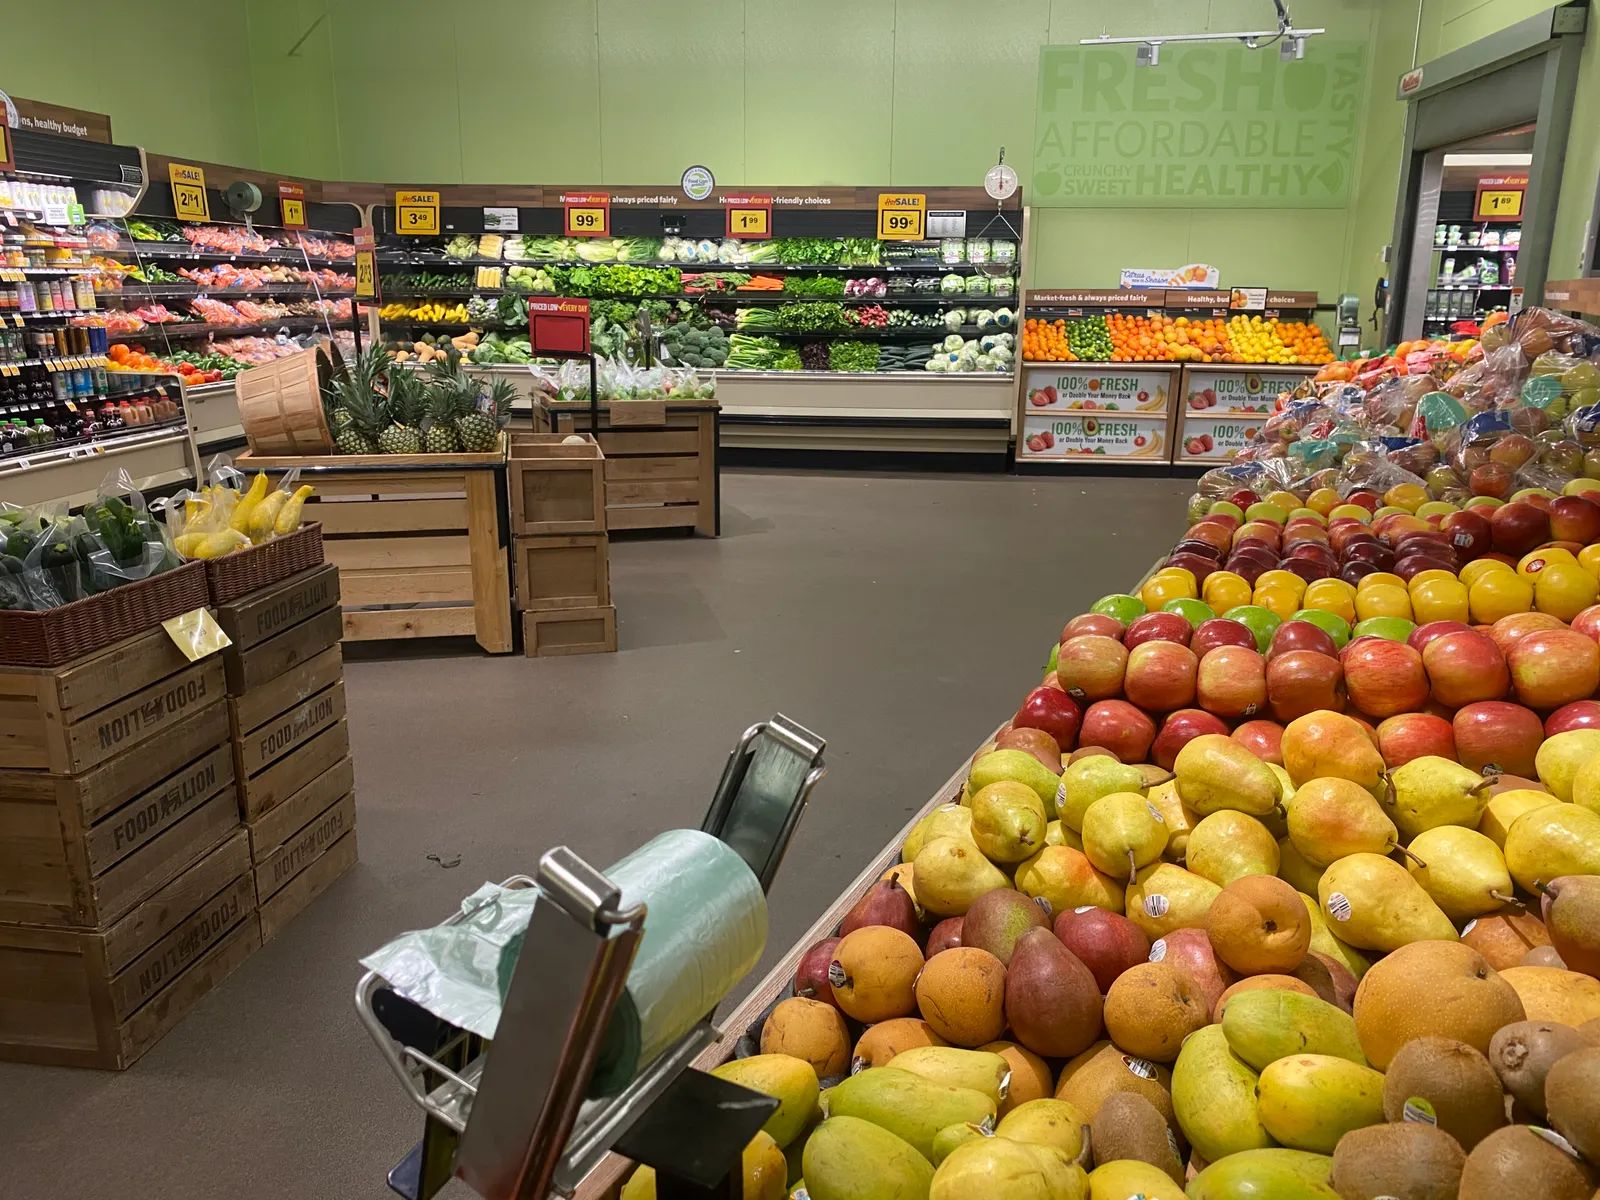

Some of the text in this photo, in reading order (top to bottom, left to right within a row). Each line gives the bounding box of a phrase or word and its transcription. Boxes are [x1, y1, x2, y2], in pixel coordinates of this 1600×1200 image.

[1040, 48, 1276, 112] FRESH
[1325, 45, 1361, 159] TASTY
[34, 116, 62, 134] healthy
[63, 122, 88, 137] budget
[1036, 119, 1316, 158] AFFORDABLE
[1063, 164, 1132, 177] CRUNCHY
[1134, 163, 1319, 196] HEALTHY
[1063, 179, 1132, 196] SWEET
[612, 196, 636, 205] always
[636, 196, 658, 205] priced
[659, 196, 678, 206] fairly
[896, 198, 920, 206] SALE!
[530, 302, 588, 313] PRICED LOW EVERY DAY
[1034, 294, 1077, 302] Market-fresh
[1084, 294, 1107, 303] always
[1108, 294, 1128, 303] priced
[1129, 294, 1148, 303] fairly
[1187, 295, 1216, 304] Healthy,
[1056, 376, 1138, 392] 100% FRESH
[1213, 379, 1245, 394] 100%
[1052, 422, 1138, 437] 100% FRESH
[1212, 425, 1244, 438] 100%
[257, 580, 328, 635] FOOD LION
[98, 674, 206, 749] FOOD LION
[260, 696, 332, 760] FOOD LION
[114, 764, 216, 850] FOOD LION
[273, 811, 343, 882] FOOD LION
[140, 895, 238, 995] FOOD LION
